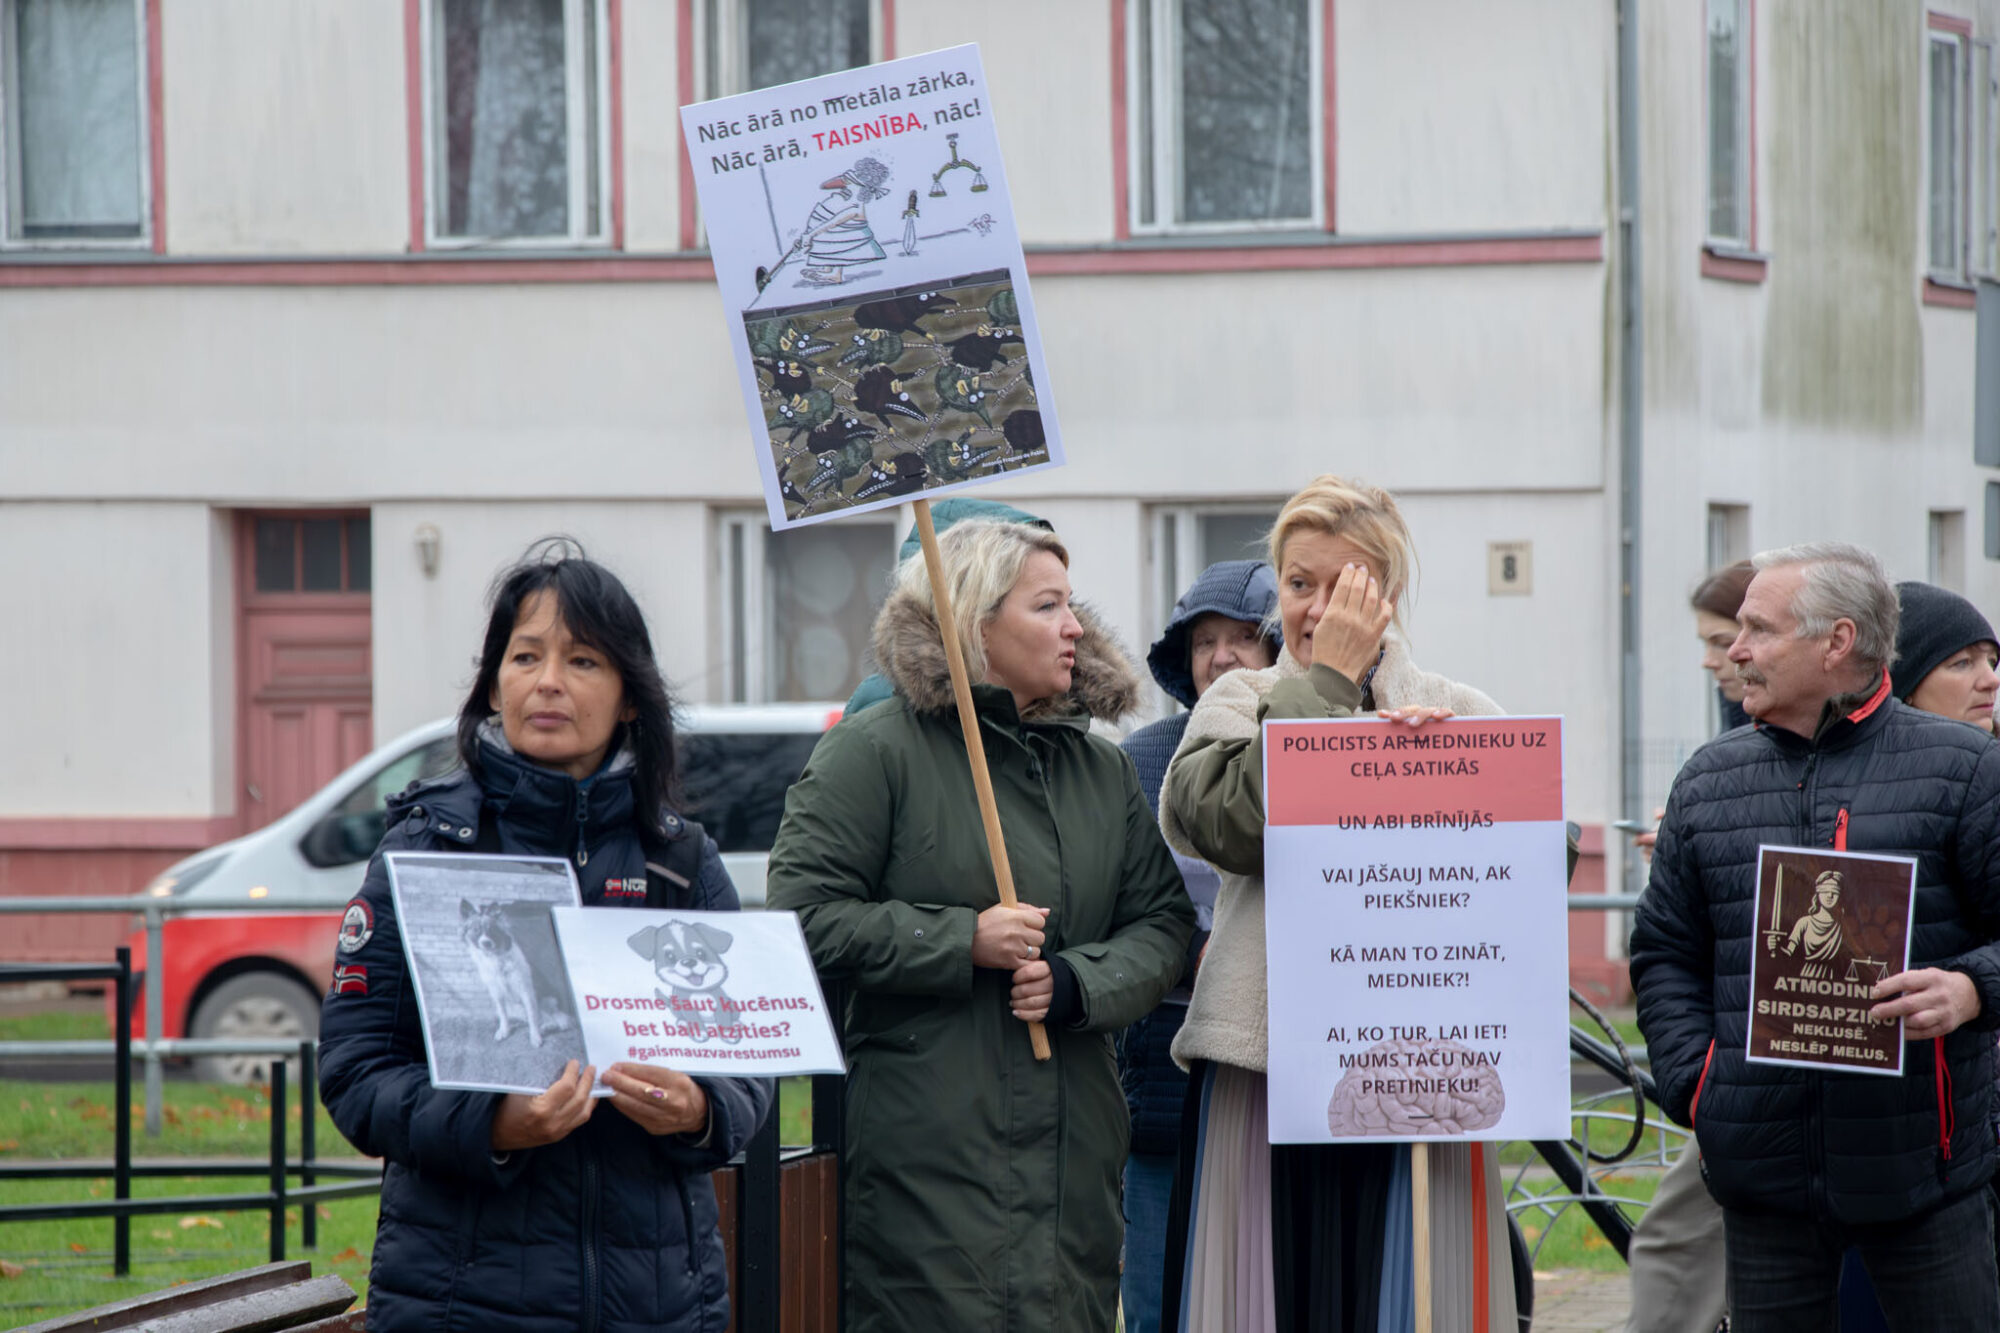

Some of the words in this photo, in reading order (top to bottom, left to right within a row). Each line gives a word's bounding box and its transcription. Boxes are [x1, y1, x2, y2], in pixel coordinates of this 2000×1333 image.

[698, 121, 742, 143] Nāc
[748, 109, 784, 132] ārā
[790, 105, 818, 123] no
[822, 84, 901, 115] metāla
[906, 71, 974, 97] zārka,
[711, 151, 757, 174] Nāc
[763, 139, 808, 163] ārā,
[811, 112, 928, 151] TAISNĪBA,
[934, 98, 982, 125] nāc!
[1284, 735, 1378, 752] POLICISTS
[1382, 735, 1408, 750] AR
[1414, 733, 1515, 749] MEDNIEKU
[1521, 732, 1547, 748] UZ
[1350, 761, 1397, 781] CEĻA
[1402, 757, 1479, 777] SATIKĀS
[1338, 815, 1366, 830] UN
[1373, 814, 1404, 830] ABI
[1410, 810, 1494, 832] BRĪNĪJĀS
[1321, 868, 1353, 883] VAI
[1357, 863, 1422, 887] JĀŠAUJ
[1428, 866, 1480, 883] MAN,
[1485, 865, 1512, 881] AK
[1364, 890, 1471, 909] PIEKŠNIEK?
[1330, 945, 1355, 962] KĀ
[1361, 947, 1406, 962] MAN
[1412, 946, 1438, 961] TO
[1443, 942, 1506, 962] ZINĀT,
[1368, 972, 1470, 988] MEDNIEK?!
[585, 995, 666, 1011] Drosme
[670, 995, 717, 1012] šaut
[719, 996, 815, 1013] kucēnus,
[622, 1020, 659, 1037] bet
[662, 1021, 702, 1037] bail
[707, 1021, 791, 1039] atzīties?
[1327, 1027, 1351, 1044] AI,
[1357, 1026, 1384, 1041] KO
[1389, 1026, 1433, 1042] TUR,
[1439, 1025, 1468, 1040] LAI
[1474, 1025, 1507, 1040] IET!
[1793, 1023, 1868, 1041] NEKLUSĒ.
[628, 1045, 802, 1061] #gaismauzvarestumsu
[1339, 1052, 1399, 1068] MUMS
[1404, 1049, 1454, 1067] TAČU
[1461, 1051, 1501, 1066] NAV
[1770, 1040, 1828, 1055] NESLĒP
[1833, 1045, 1889, 1061] MELUS.
[1363, 1078, 1480, 1094] PRETINIEKU!
